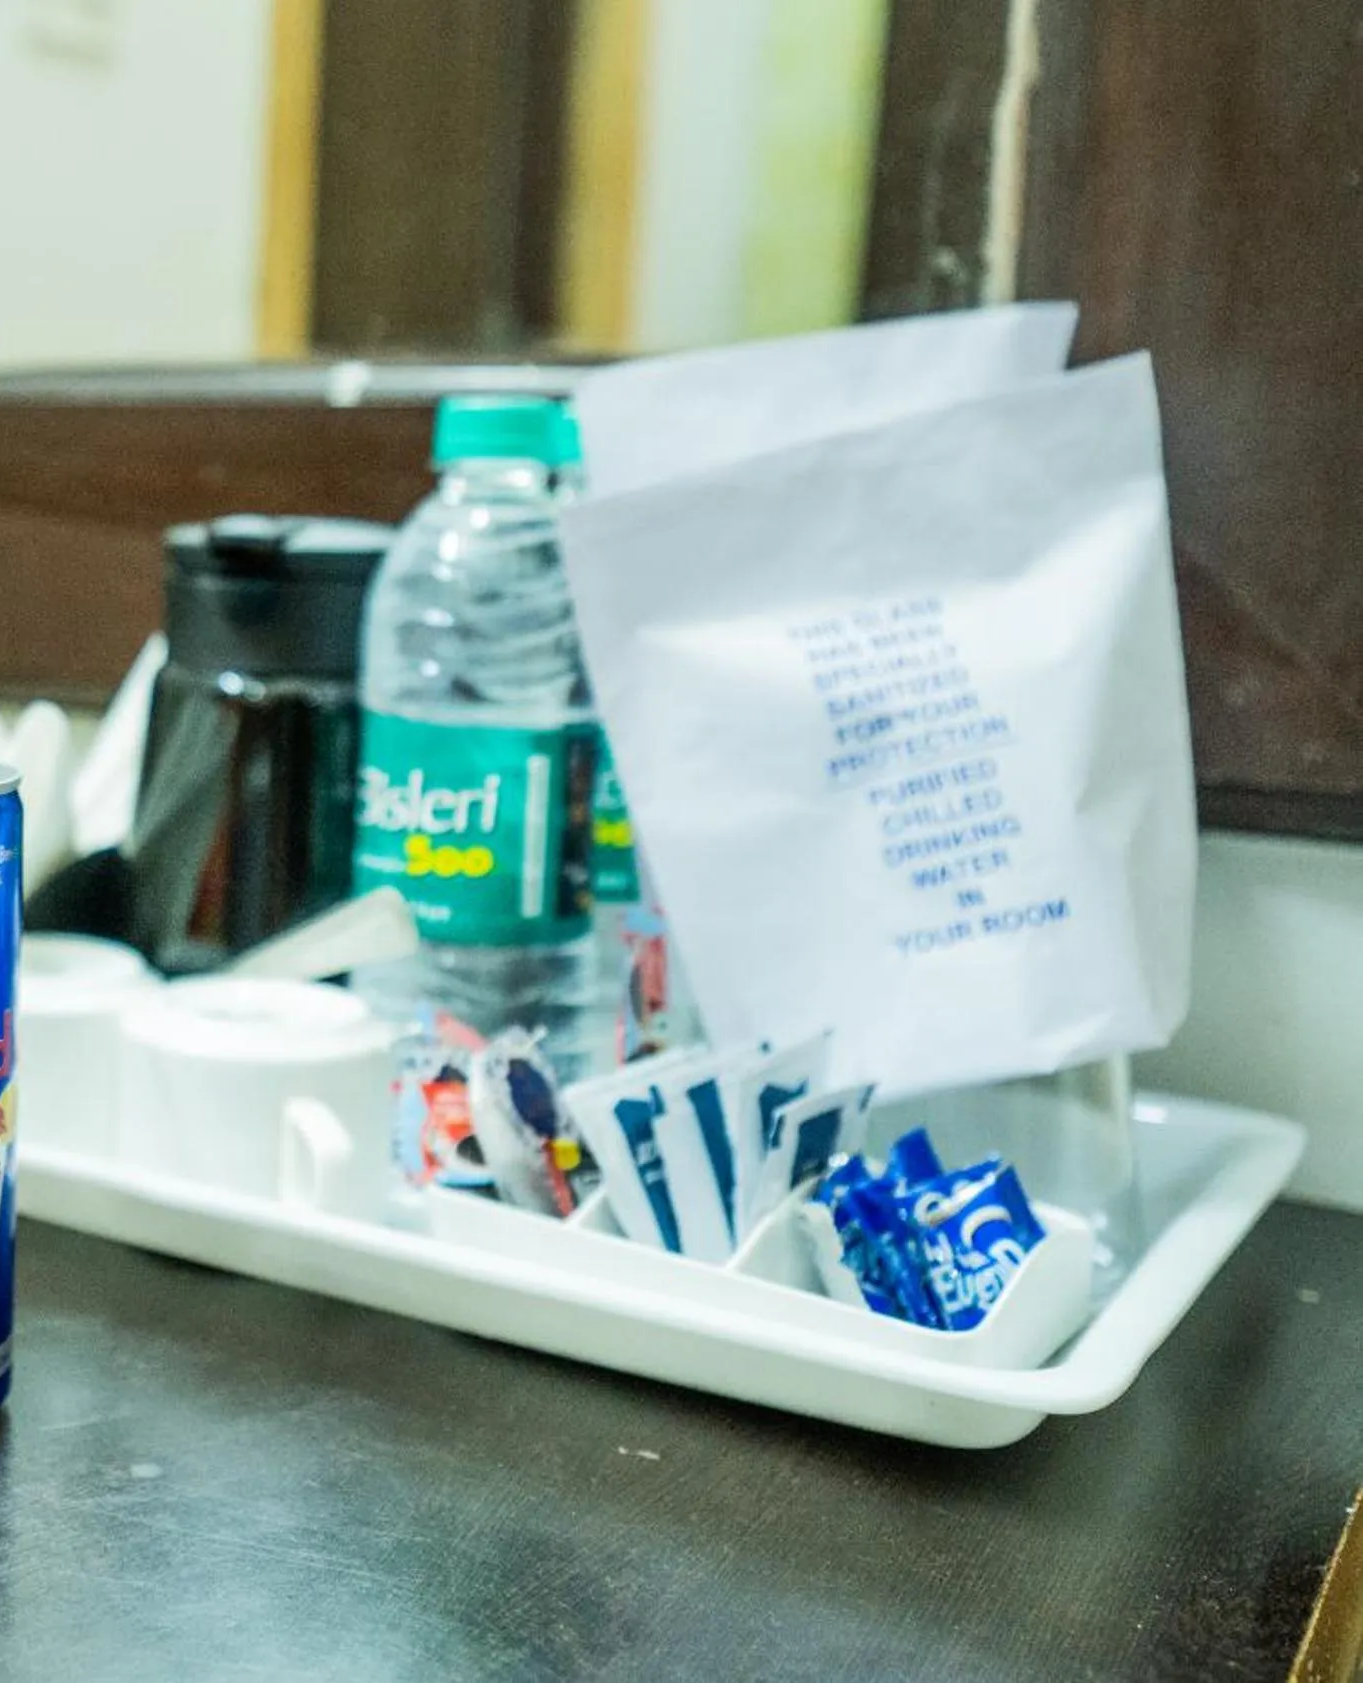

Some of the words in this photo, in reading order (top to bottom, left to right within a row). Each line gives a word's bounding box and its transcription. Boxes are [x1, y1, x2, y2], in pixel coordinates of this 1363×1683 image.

[835, 716, 894, 744] FOR
[896, 690, 980, 722] YOUR
[825, 714, 1010, 778] PROTECTION
[869, 758, 998, 804] PURIFIED
[881, 788, 1003, 835] CHILLED
[882, 814, 1023, 868] DRINKING
[912, 847, 1009, 889] WATER
[956, 889, 986, 908] IN
[893, 920, 972, 954] YOUR
[981, 897, 1070, 933] ROOM
